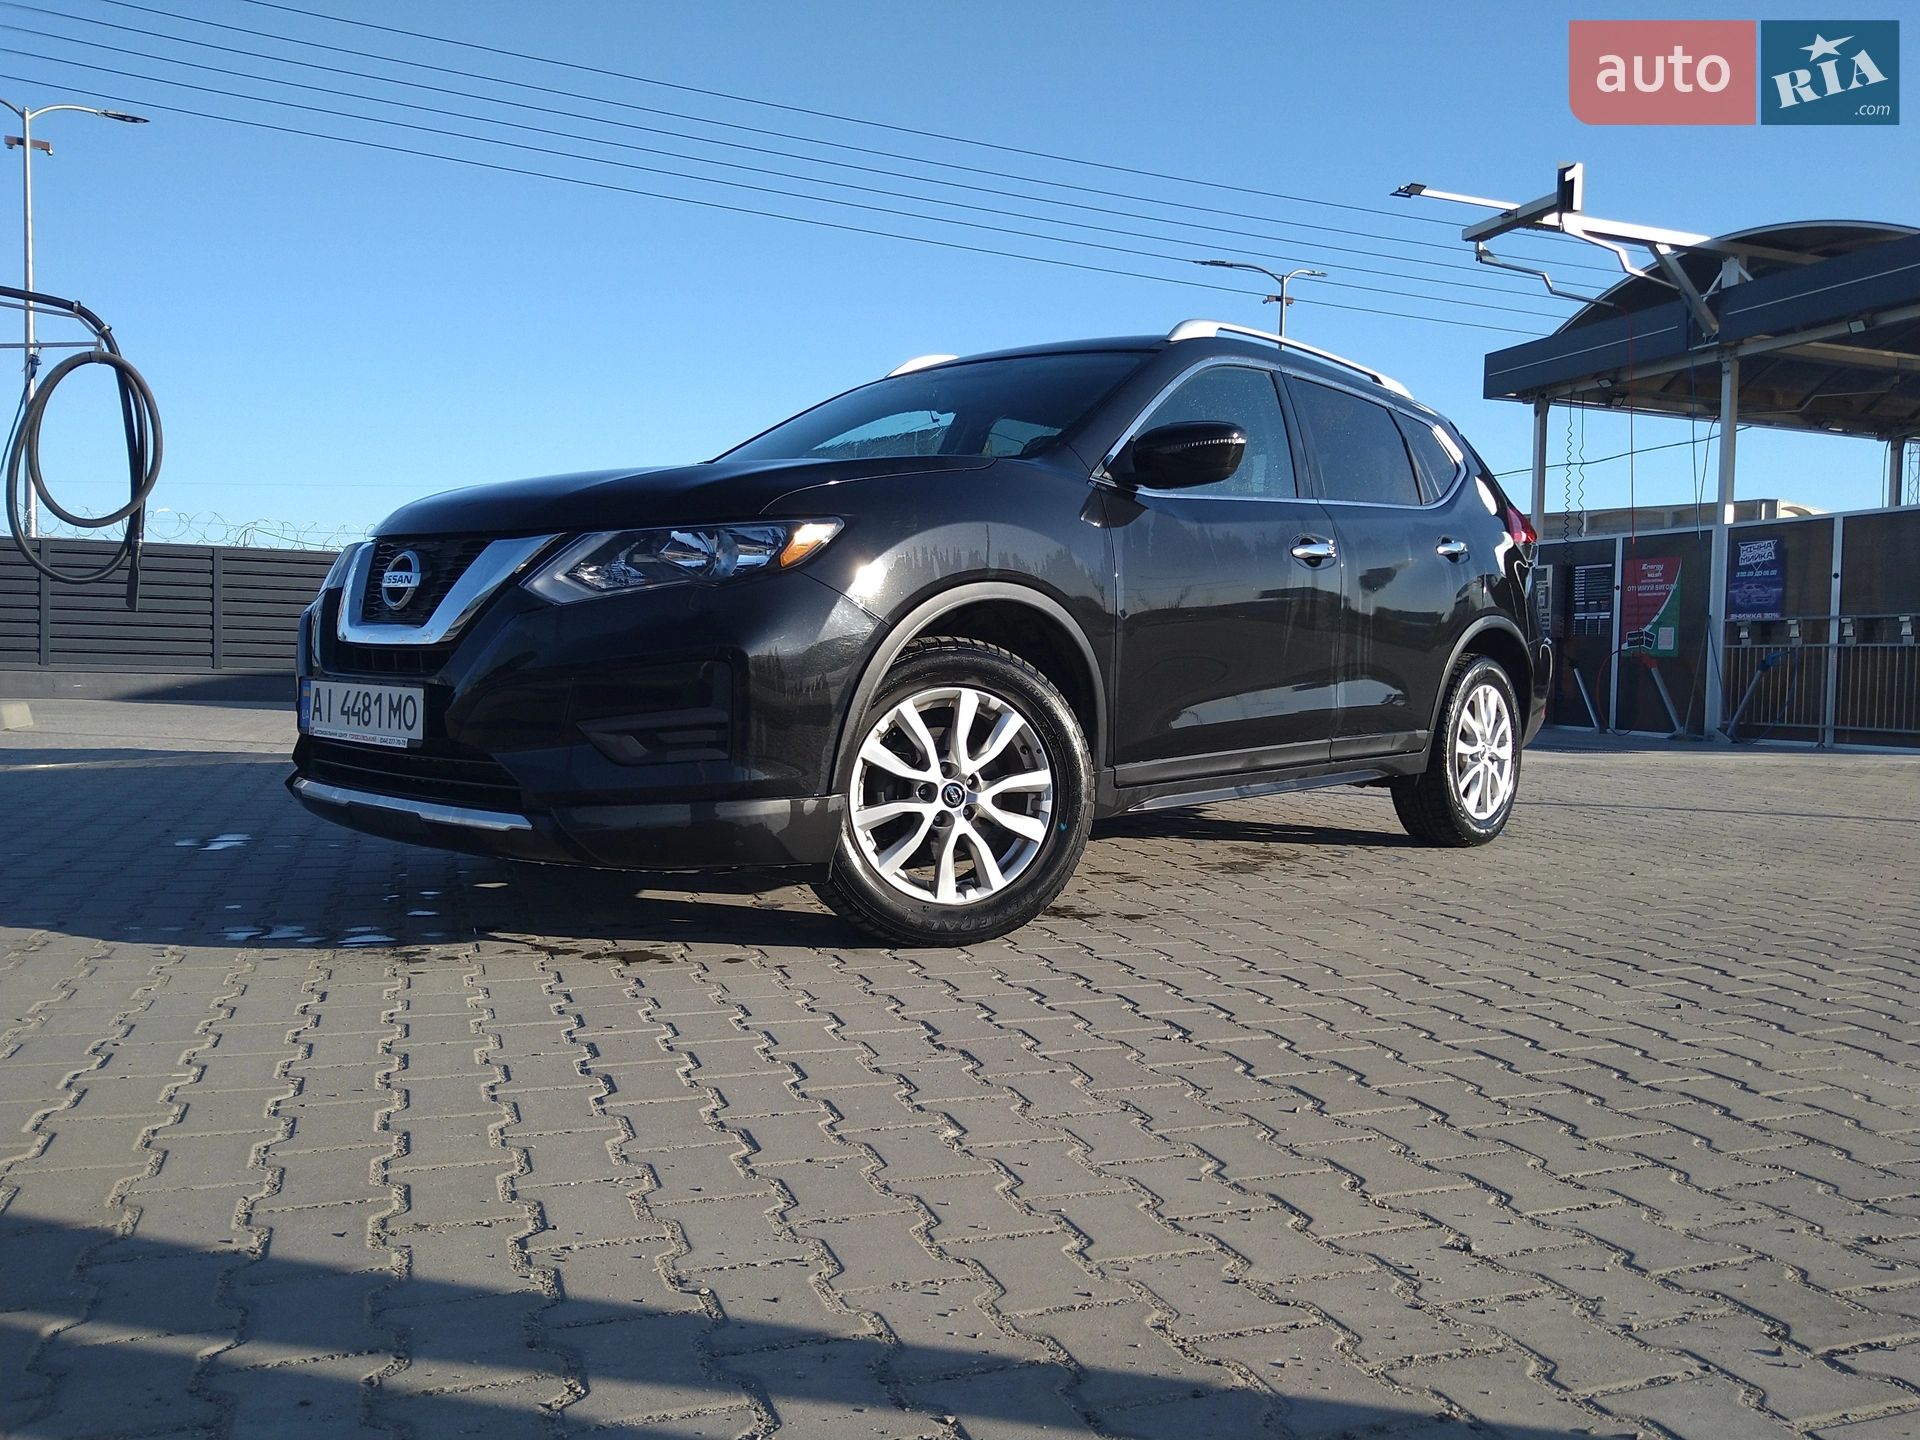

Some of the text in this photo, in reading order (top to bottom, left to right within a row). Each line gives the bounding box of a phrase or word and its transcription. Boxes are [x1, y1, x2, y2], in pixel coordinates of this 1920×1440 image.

[1565, 162, 1584, 211] 1
[1740, 551, 1774, 565] МИЙКА
[1641, 563, 1664, 571] Energy
[384, 574, 413, 584] ISSAN
[312, 687, 417, 731] AI 4481 MO
